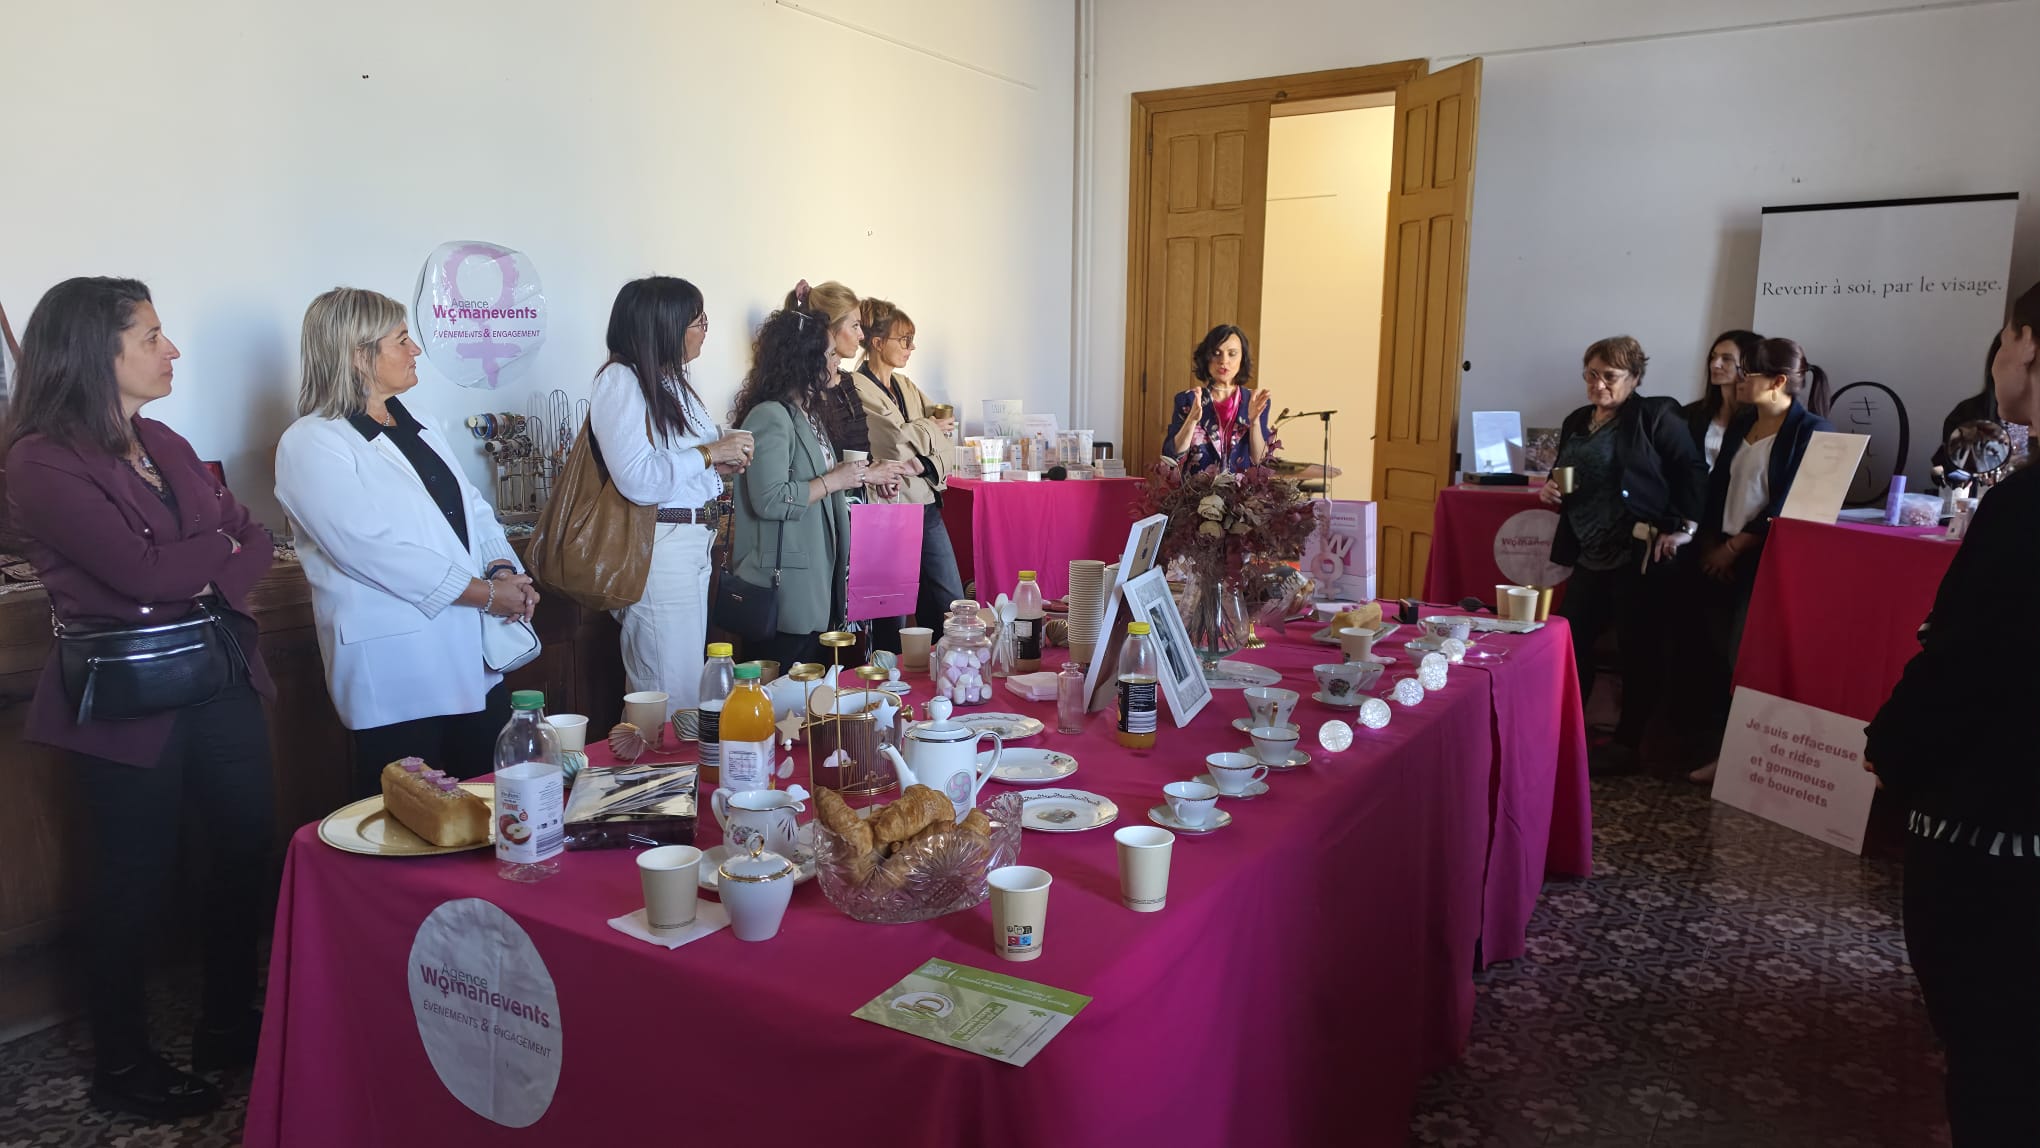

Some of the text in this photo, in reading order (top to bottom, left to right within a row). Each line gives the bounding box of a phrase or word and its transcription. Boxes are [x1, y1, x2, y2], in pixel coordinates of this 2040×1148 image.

[1762, 276, 2003, 298] Revenir à soi, par le visage.
[432, 304, 537, 324] Womanevents
[451, 298, 489, 309] Agence
[483, 328, 491, 338] &
[492, 330, 540, 338] ENGAGEMENT
[1745, 718, 1858, 762] Je suis effaceuse
[1770, 743, 1821, 769] de rides
[1750, 755, 1835, 792] et gommeuse
[1750, 771, 1828, 808] de bourelets
[441, 962, 488, 989] Agence
[420, 964, 550, 1029] Womanevents
[480, 1018, 489, 1033] &
[493, 1024, 552, 1058] ENGAGEMENT
